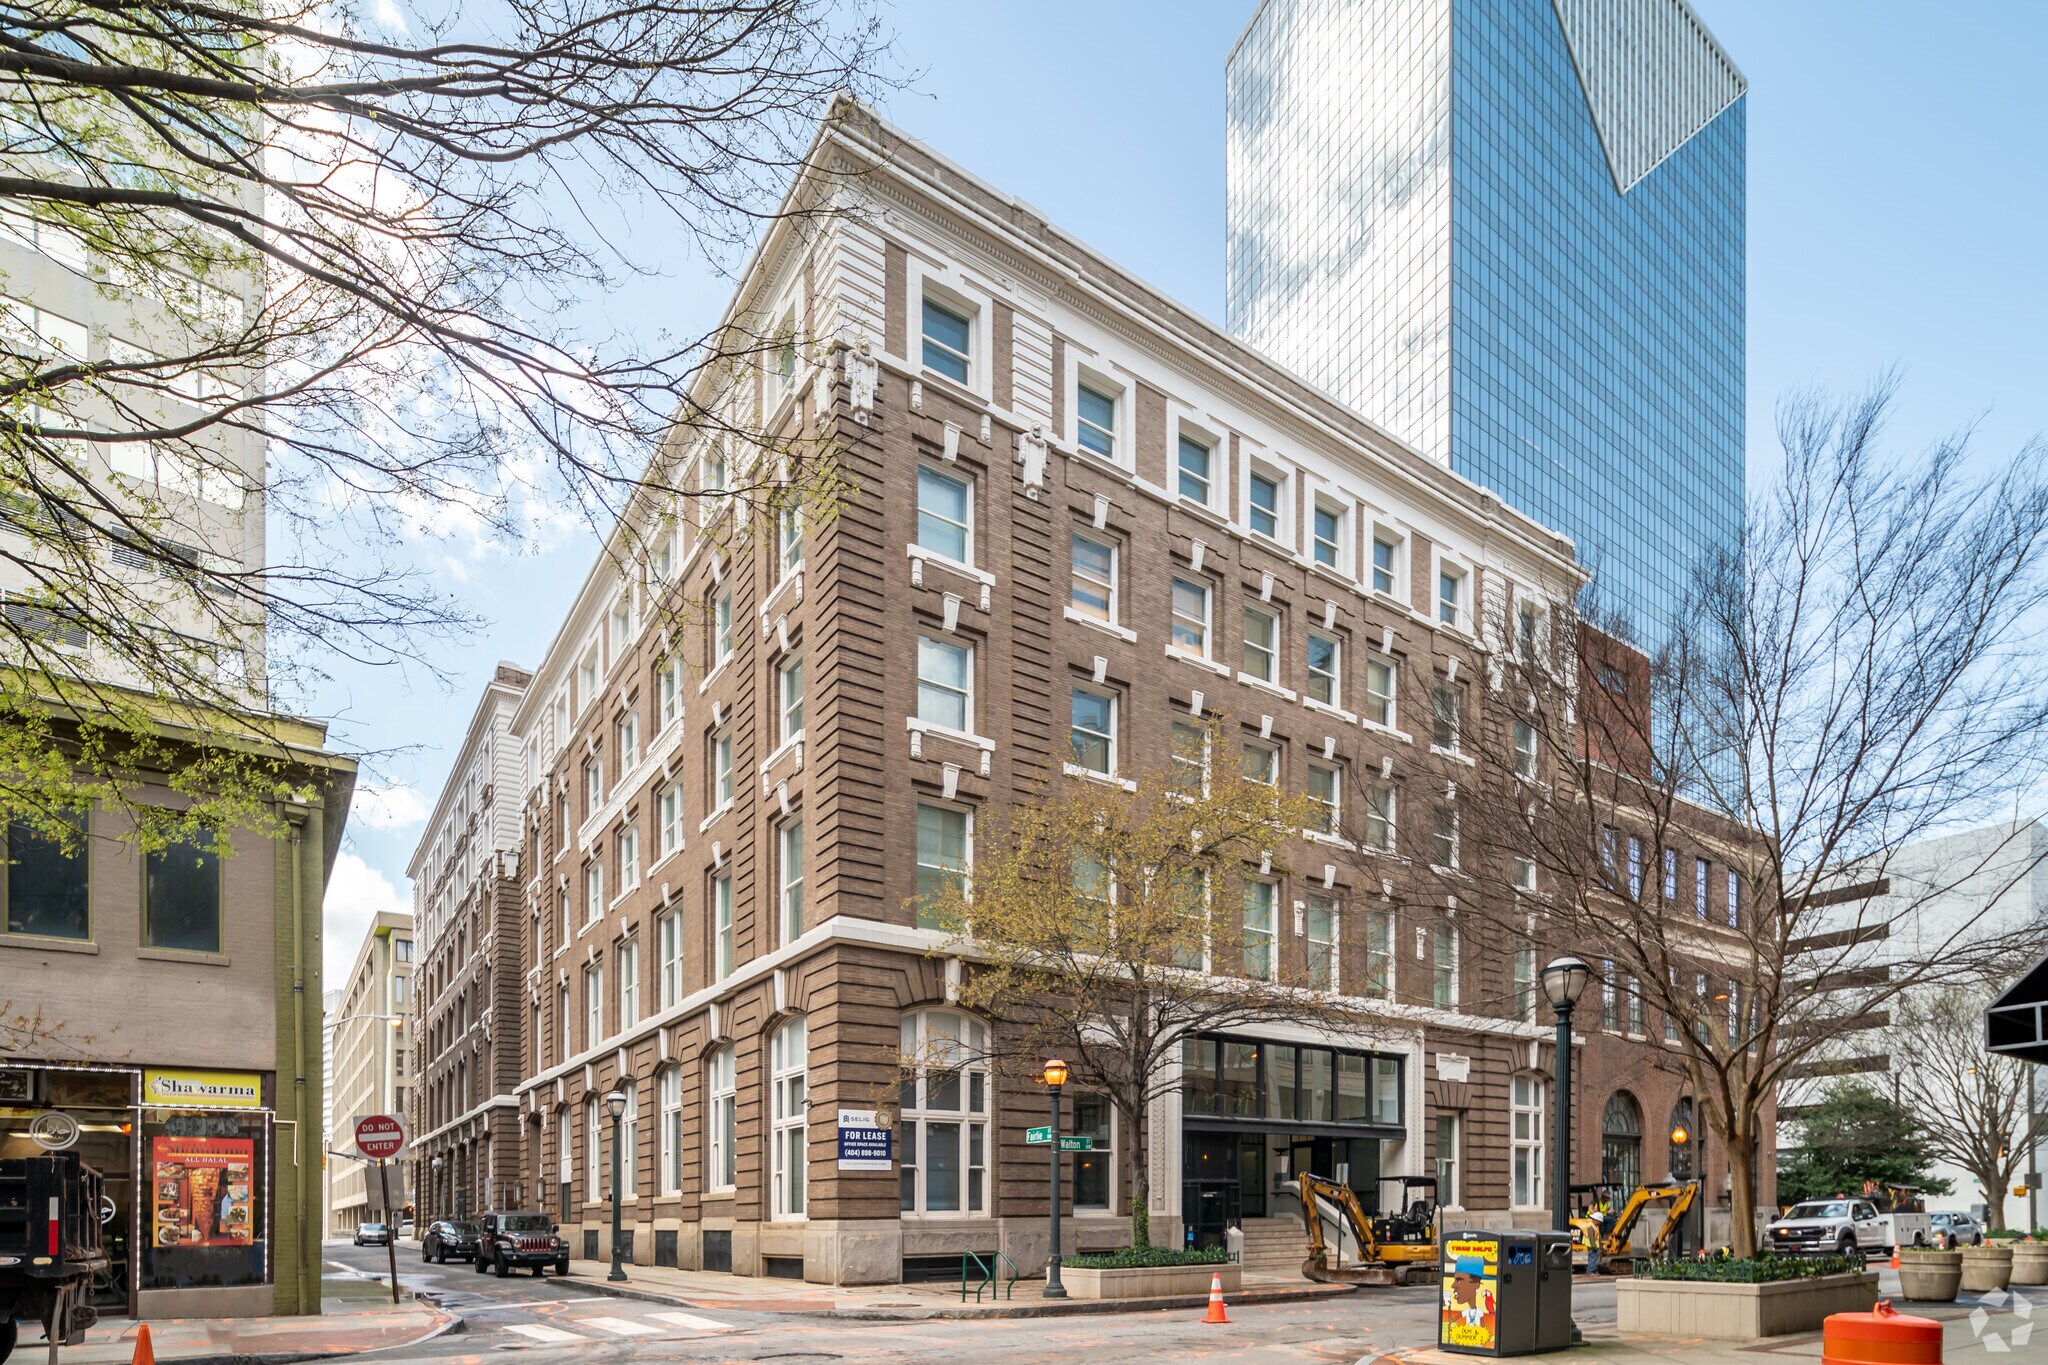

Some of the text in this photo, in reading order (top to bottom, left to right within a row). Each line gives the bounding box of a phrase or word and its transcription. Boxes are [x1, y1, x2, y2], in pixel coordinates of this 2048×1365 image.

[162, 1080, 254, 1096] Shawarma
[362, 1122, 395, 1132] DO NOT
[845, 1131, 887, 1140] FOR LEASE
[367, 1141, 395, 1151] ENTER
[1060, 1139, 1080, 1149] Walton
[844, 1149, 860, 1157] (404)
[1570, 1228, 1581, 1237] CAT
